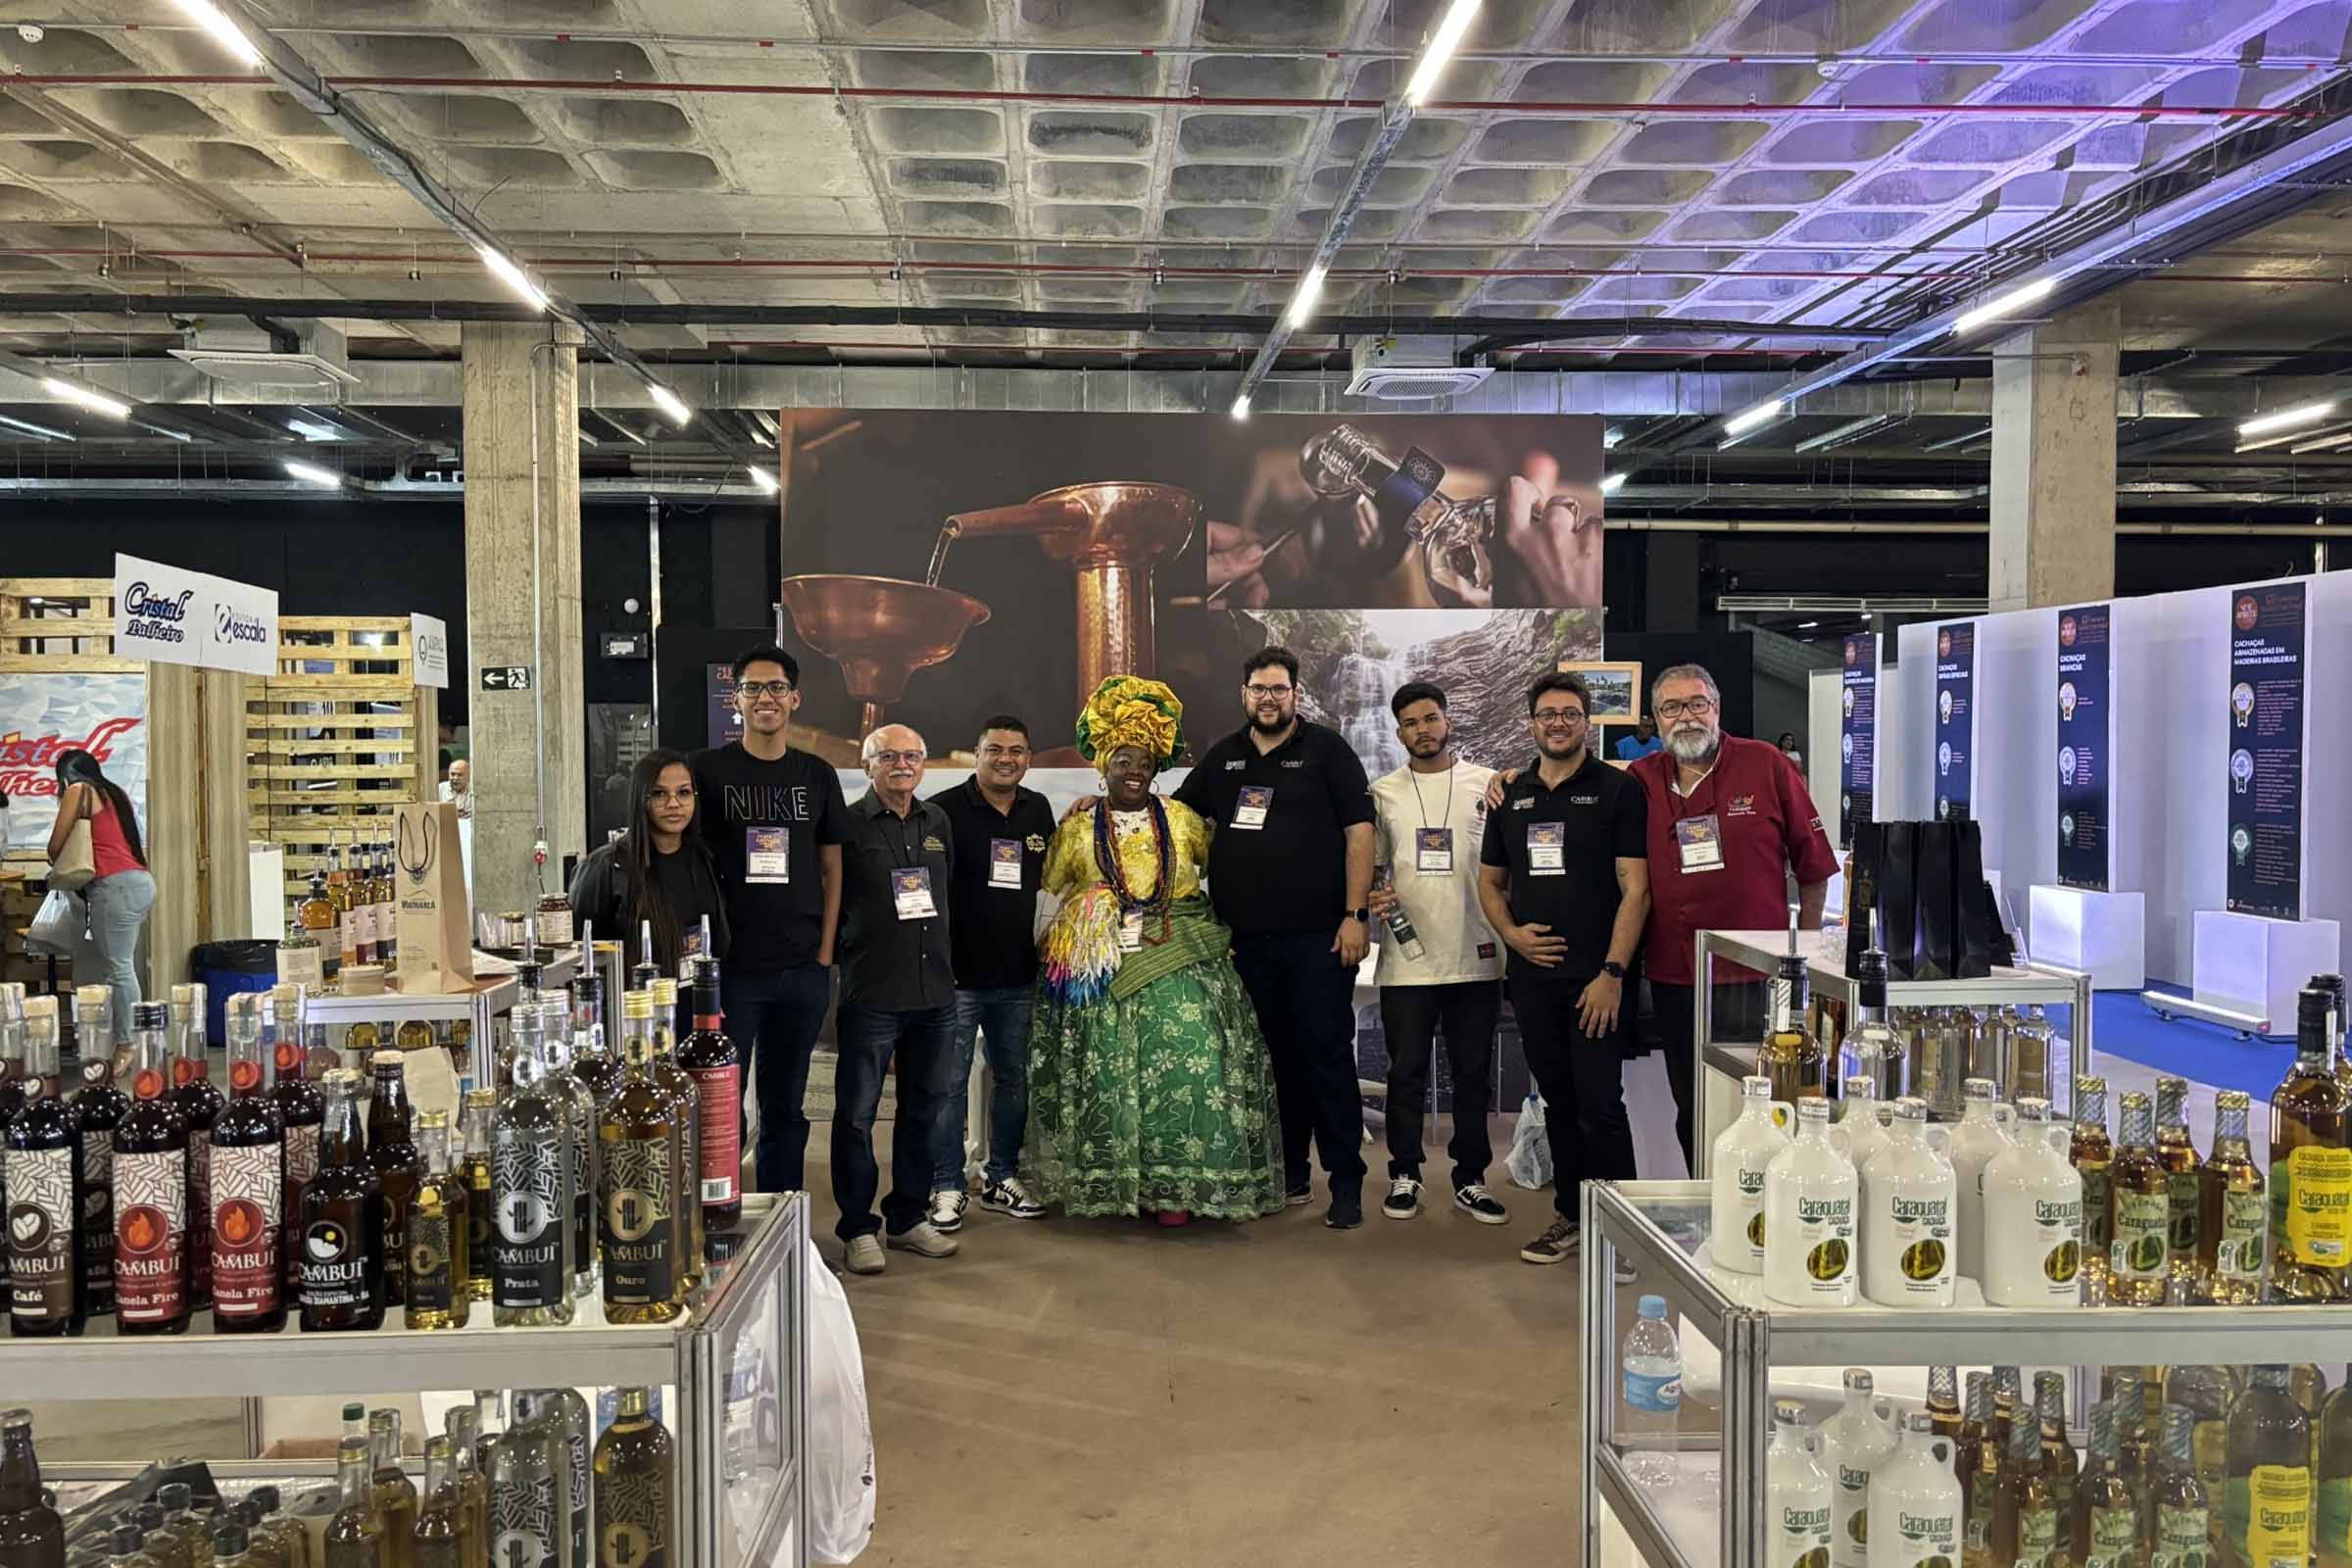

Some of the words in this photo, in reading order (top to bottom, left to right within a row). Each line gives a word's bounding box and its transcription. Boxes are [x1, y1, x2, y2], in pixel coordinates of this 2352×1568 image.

[125, 581, 194, 621] Cristal
[125, 619, 184, 643] Palheiro
[233, 618, 266, 643] escala
[724, 784, 810, 821] NIKE
[505, 1278, 539, 1289] Prata
[615, 1275, 646, 1286] Ouro
[13, 1289, 43, 1302] Café
[152, 1292, 179, 1304] Fire
[247, 1286, 274, 1298] Fire
